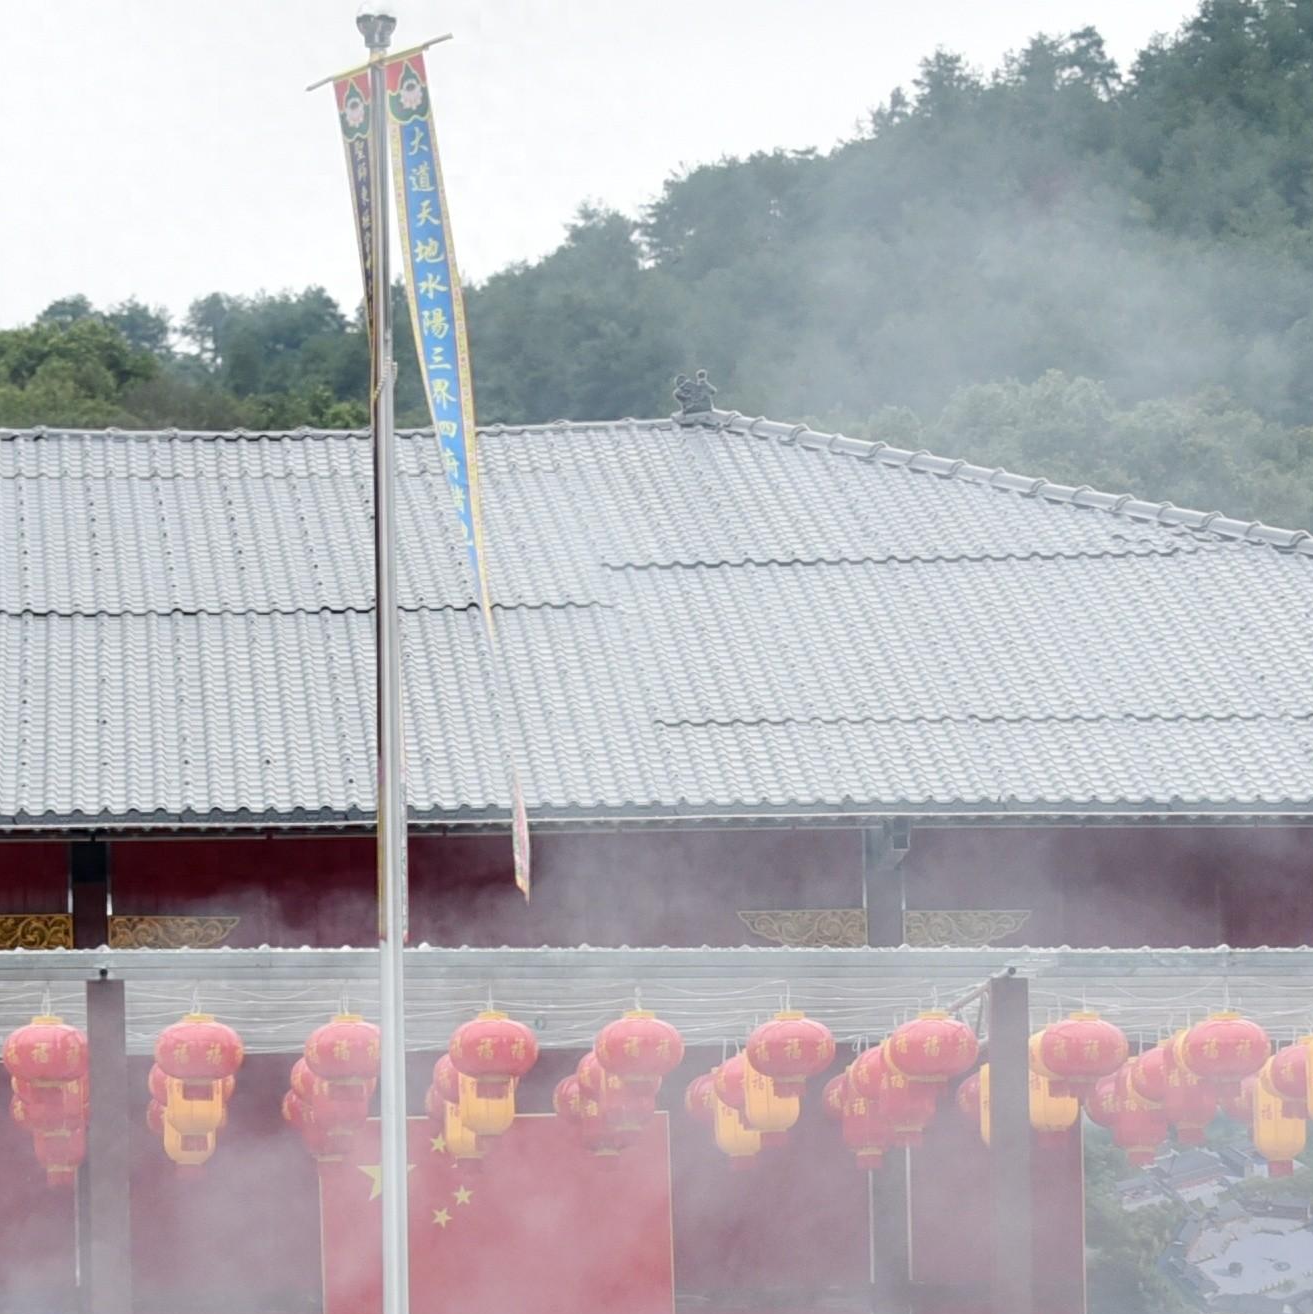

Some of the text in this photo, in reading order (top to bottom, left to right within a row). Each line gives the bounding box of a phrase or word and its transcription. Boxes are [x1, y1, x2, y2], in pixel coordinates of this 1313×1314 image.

[31, 1041, 49, 1063] 福
[174, 1042, 191, 1065] 福
[206, 1042, 222, 1064] 福
[307, 1043, 320, 1065] 福
[334, 1039, 350, 1061] 福
[478, 1038, 494, 1060] 福
[510, 1038, 526, 1058] 福
[625, 1036, 640, 1057] 福
[657, 1040, 671, 1058] 福
[756, 1040, 769, 1061] 福
[786, 1038, 802, 1059] 福
[897, 1034, 908, 1054] 福
[925, 1035, 940, 1056] 福
[1054, 1038, 1067, 1057] 福
[1085, 1039, 1100, 1058] 福
[1203, 1036, 1220, 1058] 福
[1236, 1038, 1251, 1057] 福
[753, 1071, 766, 1091] 福
[1282, 1061, 1294, 1082] 福
